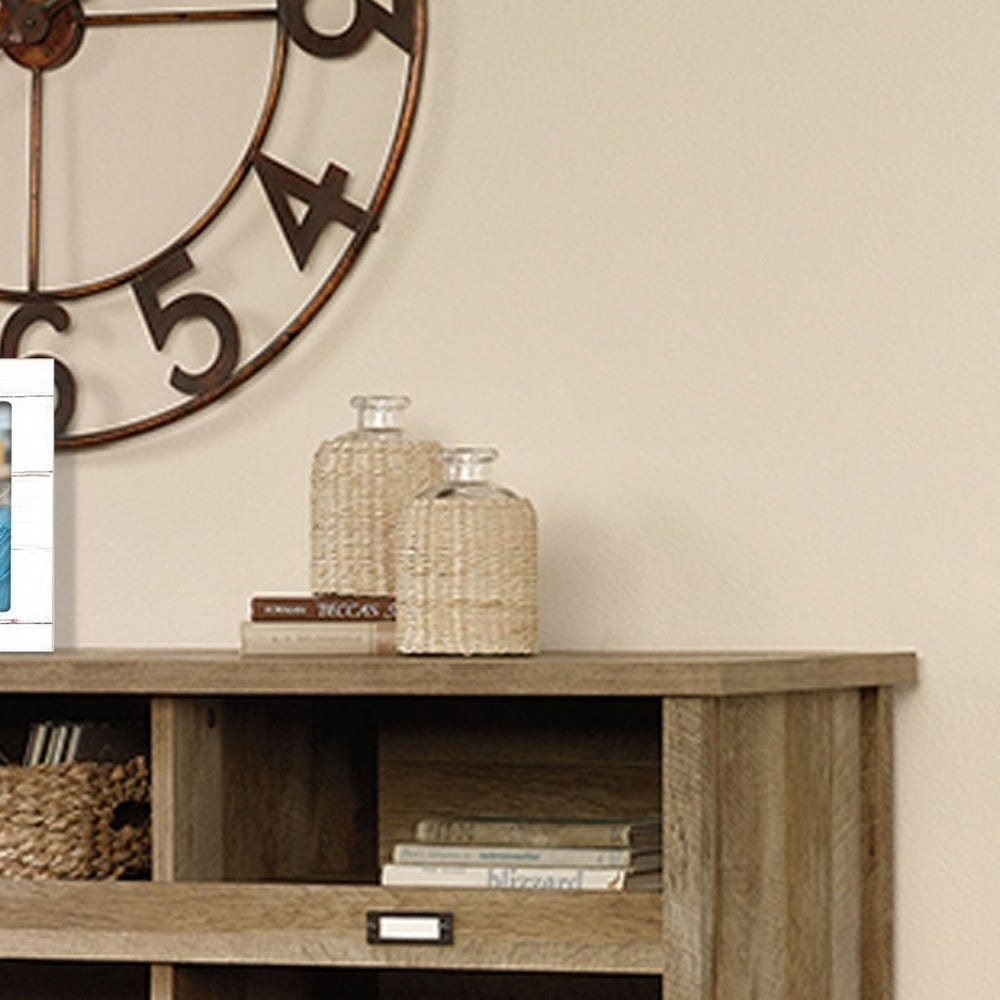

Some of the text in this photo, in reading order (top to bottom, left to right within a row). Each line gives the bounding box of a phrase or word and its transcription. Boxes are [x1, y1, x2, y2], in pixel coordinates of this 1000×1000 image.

[254, 153, 376, 271] 4
[131, 248, 240, 396] 5
[487, 867, 583, 890] blizzard
